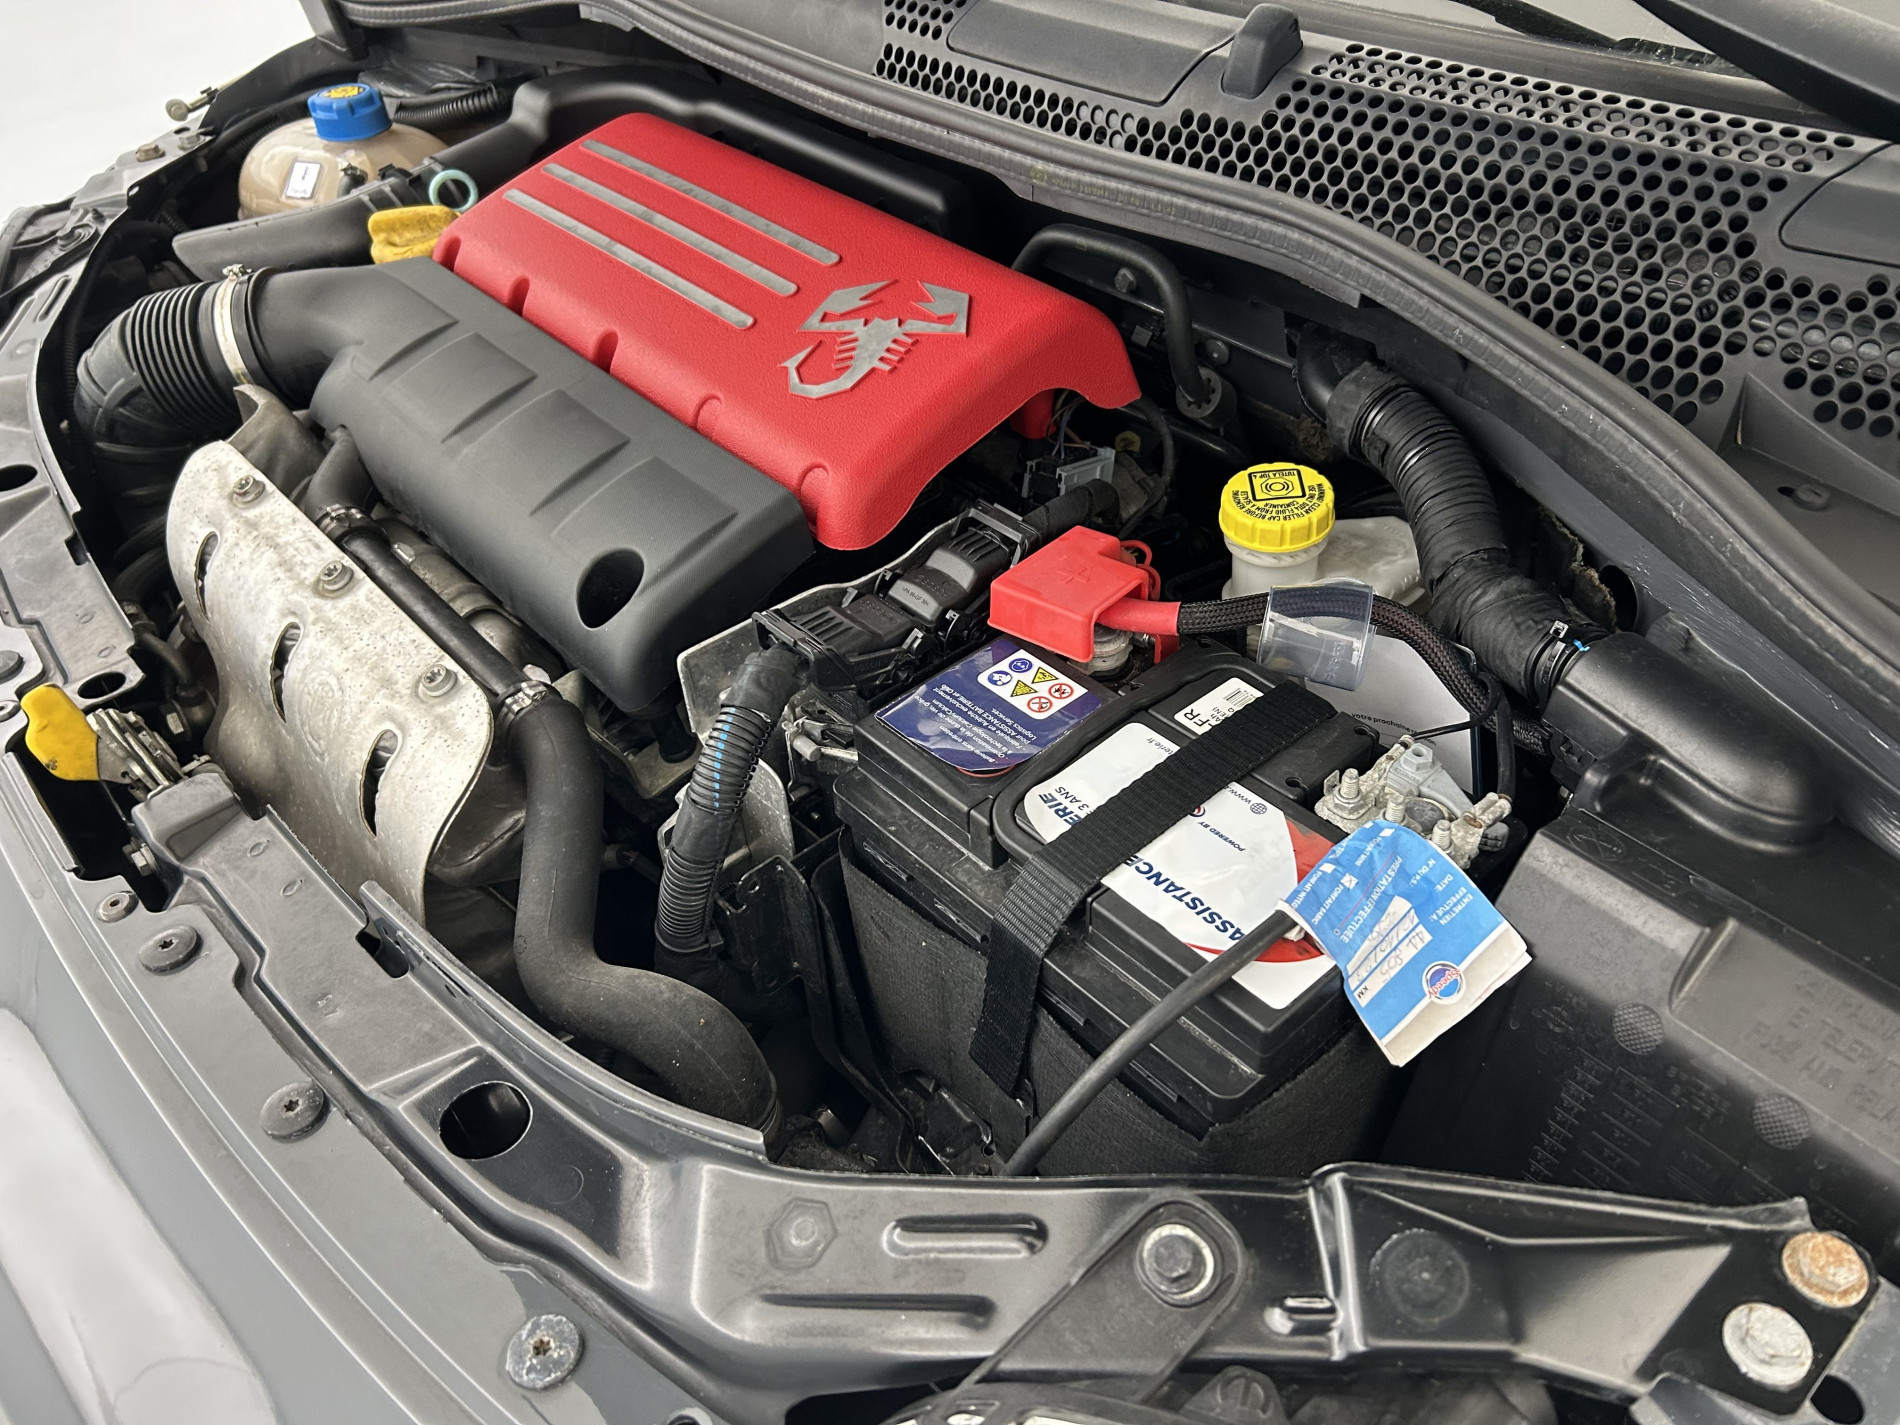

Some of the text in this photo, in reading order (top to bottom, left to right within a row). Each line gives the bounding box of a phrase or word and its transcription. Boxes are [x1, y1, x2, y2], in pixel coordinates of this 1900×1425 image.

[1246, 508, 1266, 520] BEFORE
[1255, 505, 1273, 515] FROM
[1264, 500, 1299, 508] CONTAINER
[1275, 507, 1296, 515] FLUID
[1304, 503, 1320, 514] CLEAN
[1283, 513, 1304, 521] FILLER
[931, 685, 969, 713] exclusivement
[957, 694, 984, 714] BATTERIE
[965, 709, 990, 727] Autriche
[981, 710, 1017, 737] ASSISTANCE
[989, 706, 1036, 740] Logistics Services.
[1373, 717, 1410, 732] prochaine
[970, 724, 1003, 749] technologie
[1055, 786, 1077, 805] ANS
[1039, 792, 1083, 826] ERIE
[1077, 803, 1089, 812] 3
[1199, 821, 1246, 852] POWERED BY
[1369, 854, 1402, 901] PRESTATION
[1417, 864, 1429, 876] DU
[1124, 855, 1245, 941] ASSISTANCE
[1310, 883, 1344, 925] FORFAIT BASIC
[1438, 892, 1473, 925] ENTRETIEN
[1339, 896, 1376, 943] EFFECTUÉE
[1357, 985, 1369, 999] KM
[1428, 968, 1462, 999] Speedy
